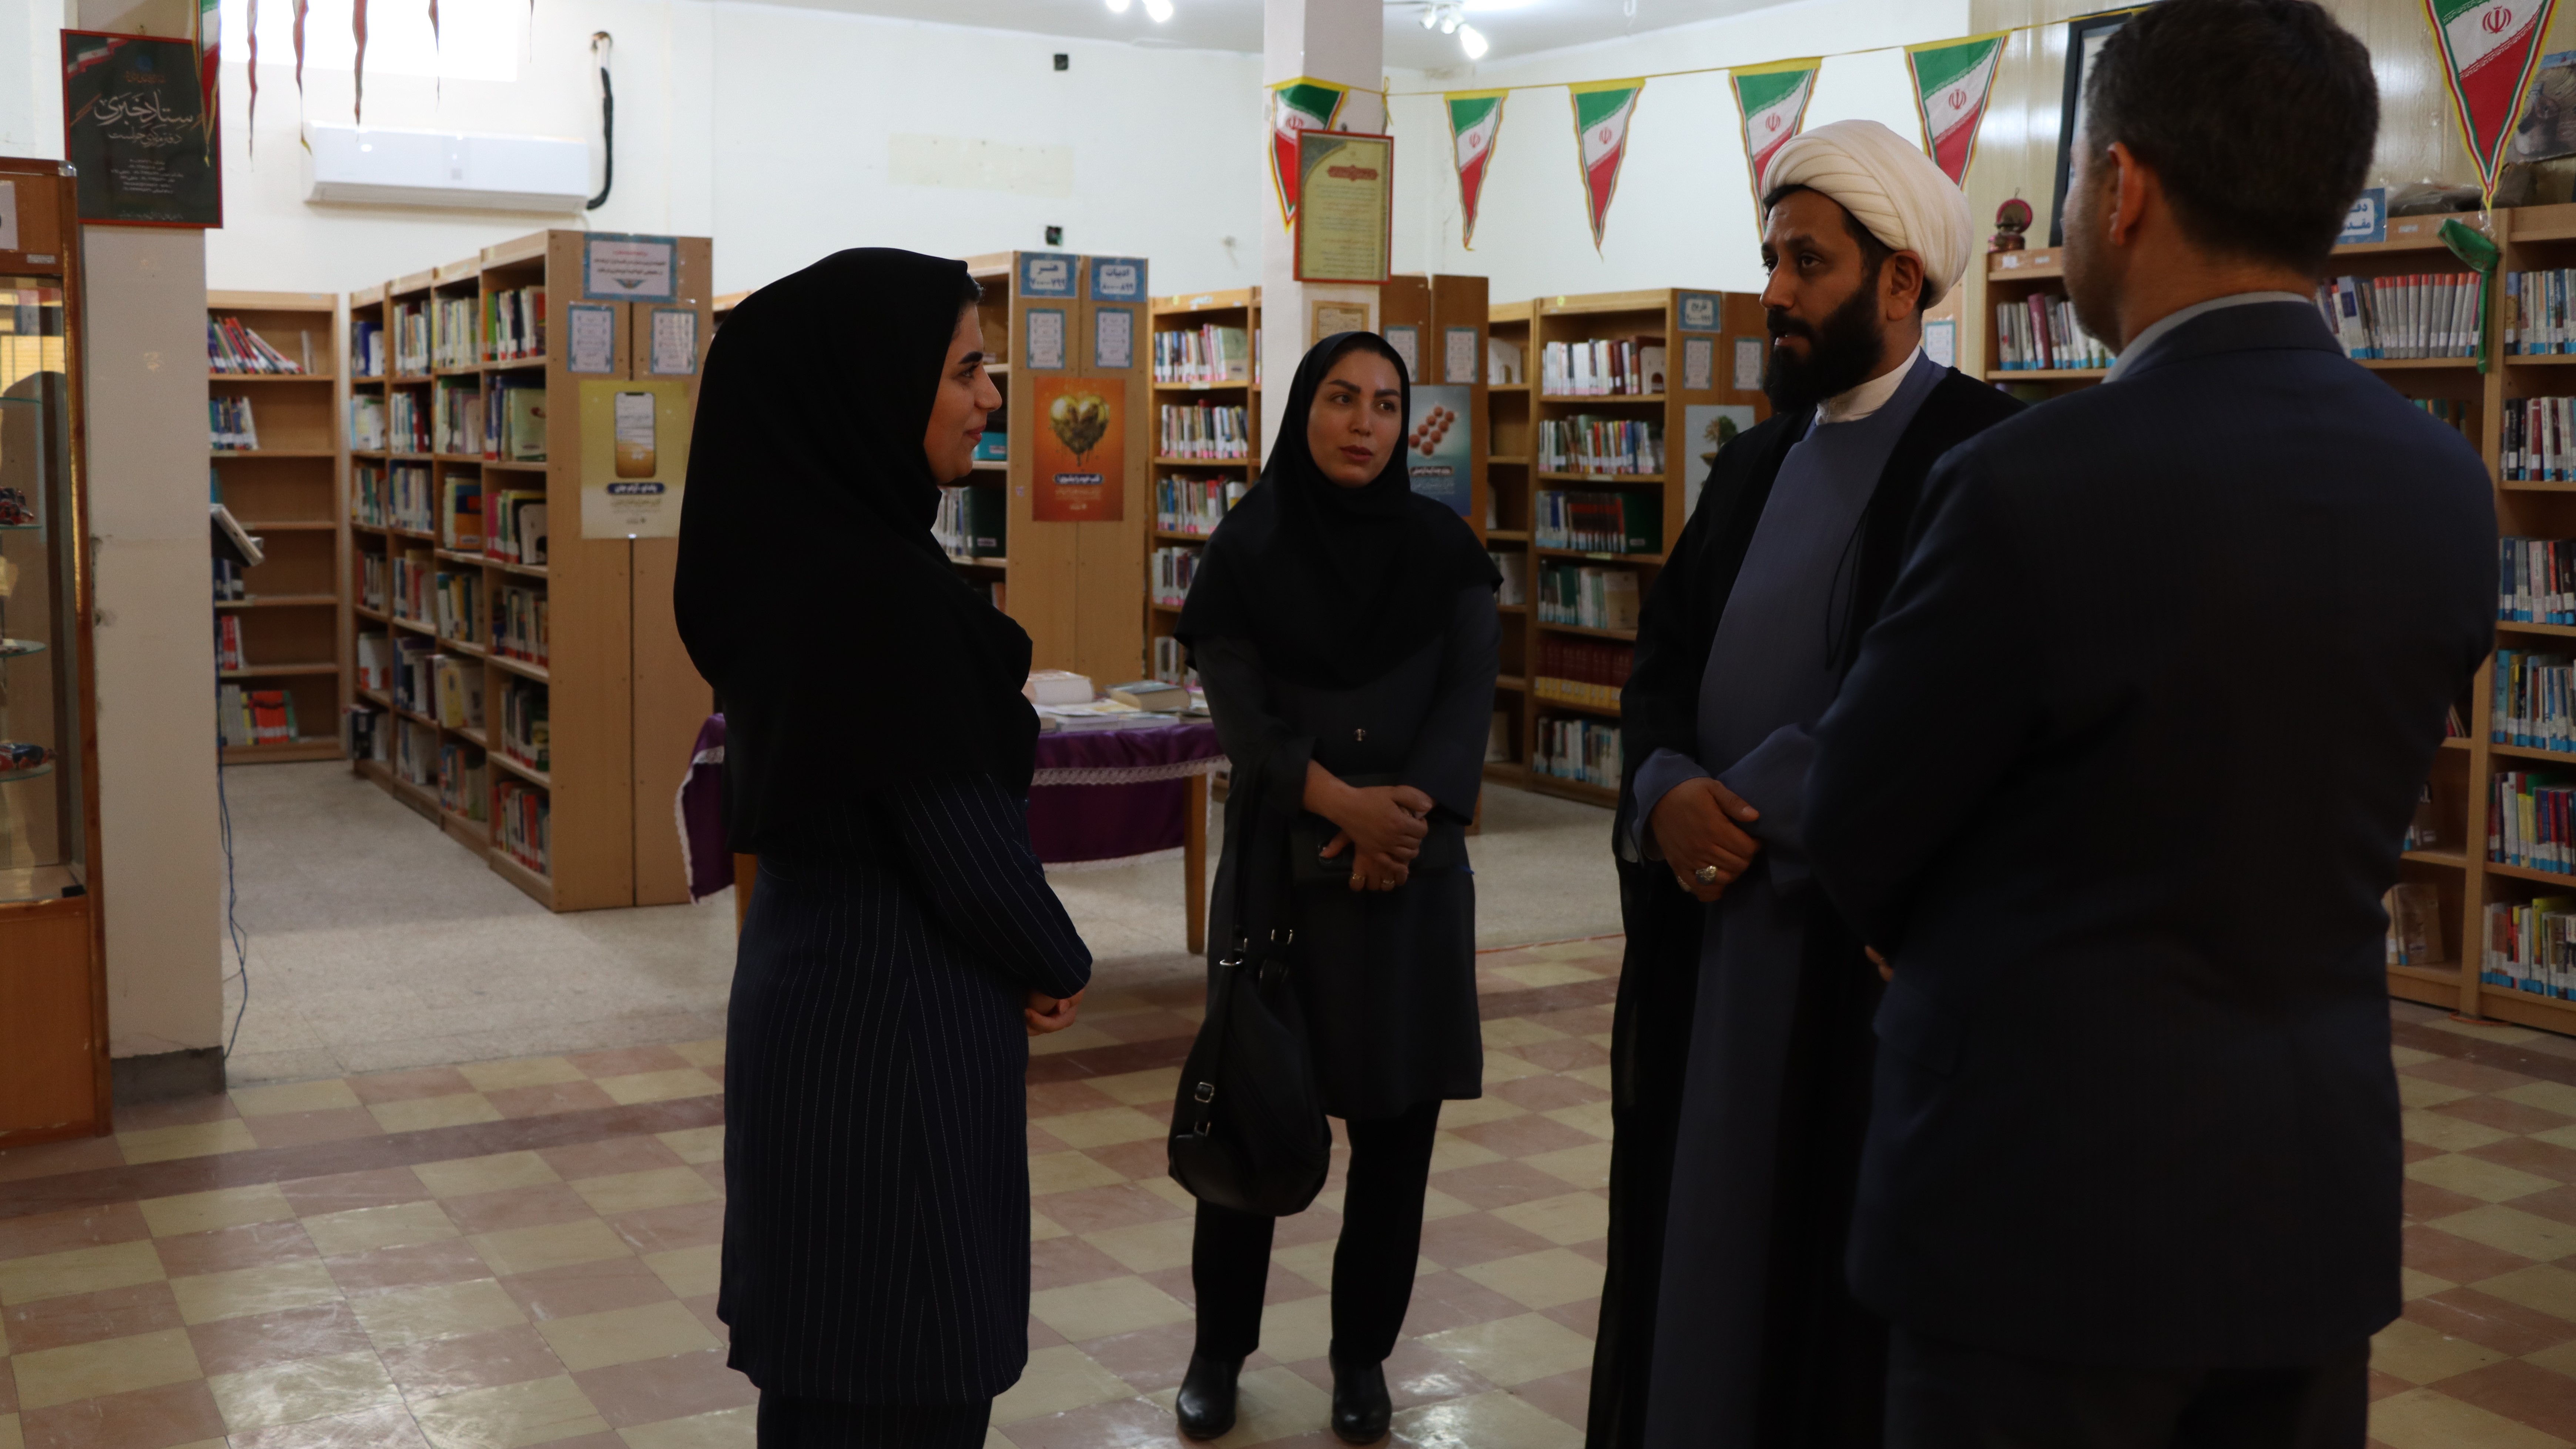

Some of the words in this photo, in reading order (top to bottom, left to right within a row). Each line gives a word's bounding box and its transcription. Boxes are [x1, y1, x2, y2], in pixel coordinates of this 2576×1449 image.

[140, 90, 193, 123] ستاد
[1037, 263, 1059, 275] هنر
[1105, 268, 1130, 279] ادبیات
